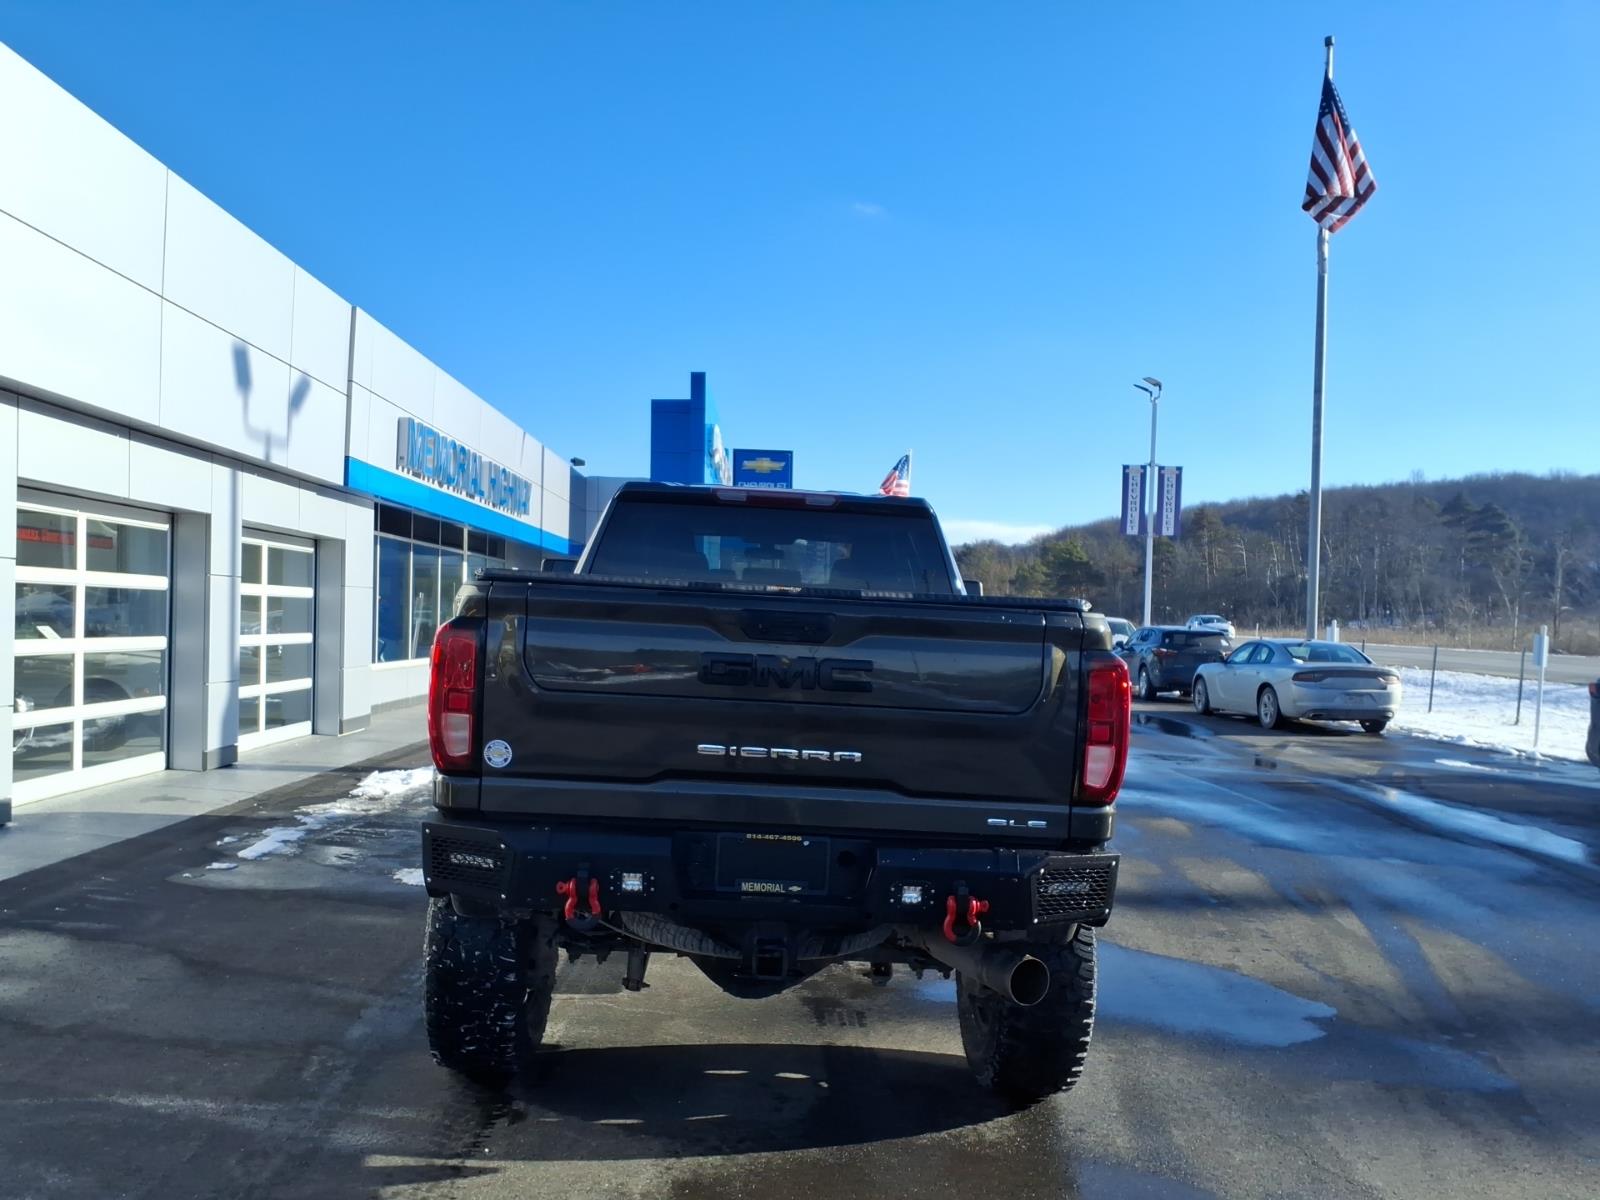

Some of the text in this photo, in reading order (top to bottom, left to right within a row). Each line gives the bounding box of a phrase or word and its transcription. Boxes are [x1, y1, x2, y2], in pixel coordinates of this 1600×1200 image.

[397, 417, 485, 498] MEMORIAL
[698, 651, 874, 692] GMC
[697, 744, 862, 763] SIERRA
[987, 818, 1047, 828] SLE
[741, 882, 785, 893] MEMORIAL
